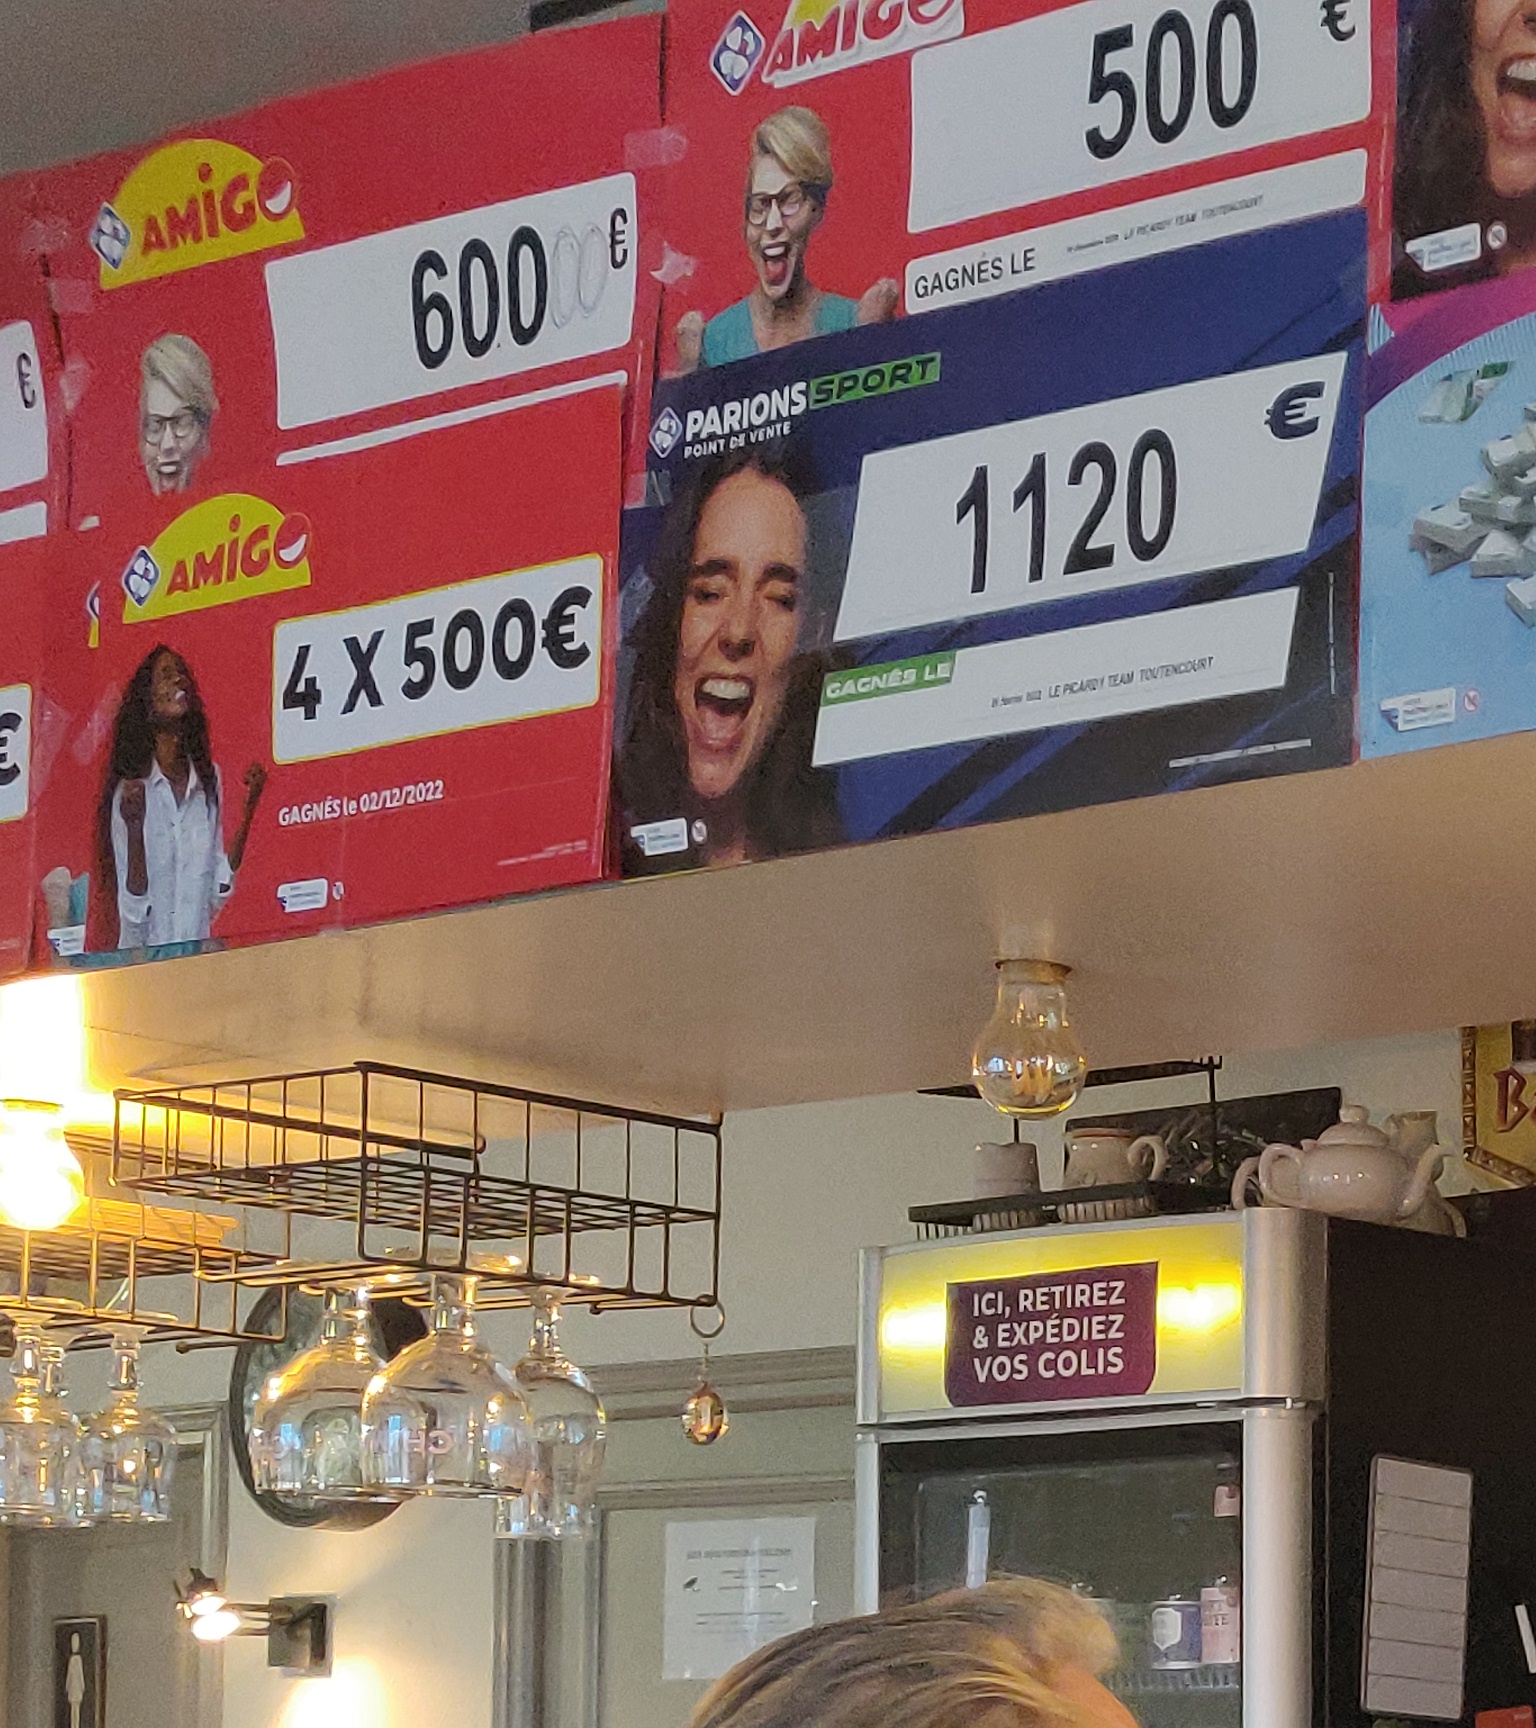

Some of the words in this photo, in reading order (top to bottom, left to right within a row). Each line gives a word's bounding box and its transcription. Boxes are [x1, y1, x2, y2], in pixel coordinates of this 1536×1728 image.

[1085, 0, 1258, 160] 500
[914, 251, 1004, 300] GAGNÉS
[1008, 246, 1037, 276] LE
[685, 381, 807, 442] PARIONS
[811, 356, 938, 404] SPORT
[684, 439, 725, 459] POINT
[750, 421, 791, 444] VENTE
[955, 427, 1178, 594] 1120
[1265, 381, 1324, 440] €
[282, 646, 322, 721] 4
[342, 628, 387, 716] X
[402, 586, 593, 700] 500€
[824, 664, 918, 700] GAGNÉS
[920, 658, 951, 684] LE
[279, 798, 343, 829] GAGNÉS
[344, 793, 357, 817] le
[359, 778, 444, 815] 02/12/2022
[972, 1290, 1011, 1319] ICI,
[1018, 1280, 1126, 1313] RETIREZ
[972, 1325, 988, 1349] &
[997, 1312, 1125, 1348] EXPÉDIEZ
[973, 1353, 1029, 1383] VOS
[1038, 1346, 1124, 1379] COLIS
